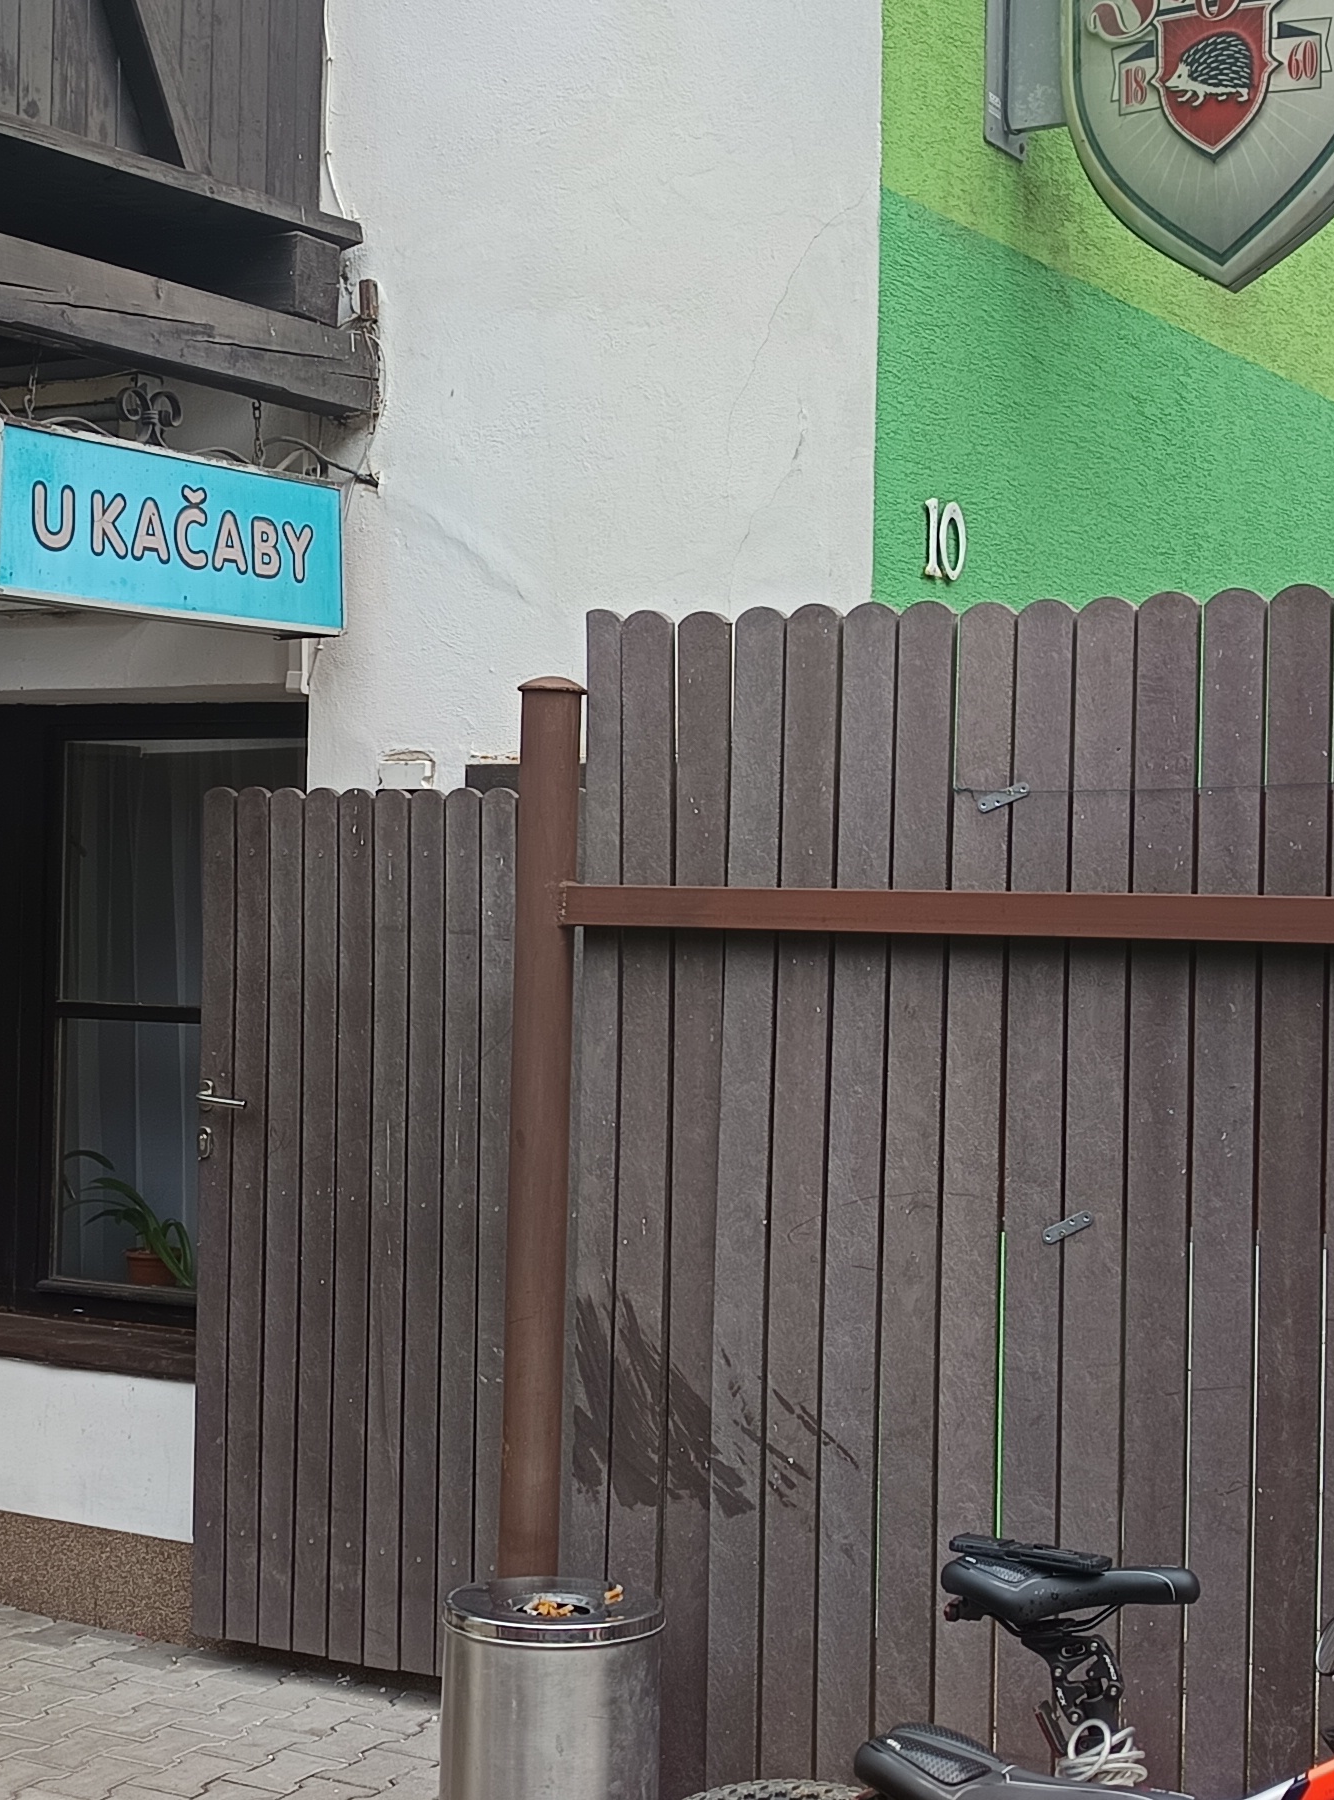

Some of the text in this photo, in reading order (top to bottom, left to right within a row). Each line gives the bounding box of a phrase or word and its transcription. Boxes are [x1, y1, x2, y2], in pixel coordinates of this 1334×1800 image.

[1123, 40, 1318, 106] 18 60
[32, 480, 313, 583] U KAČABY
[924, 497, 966, 580] 10
